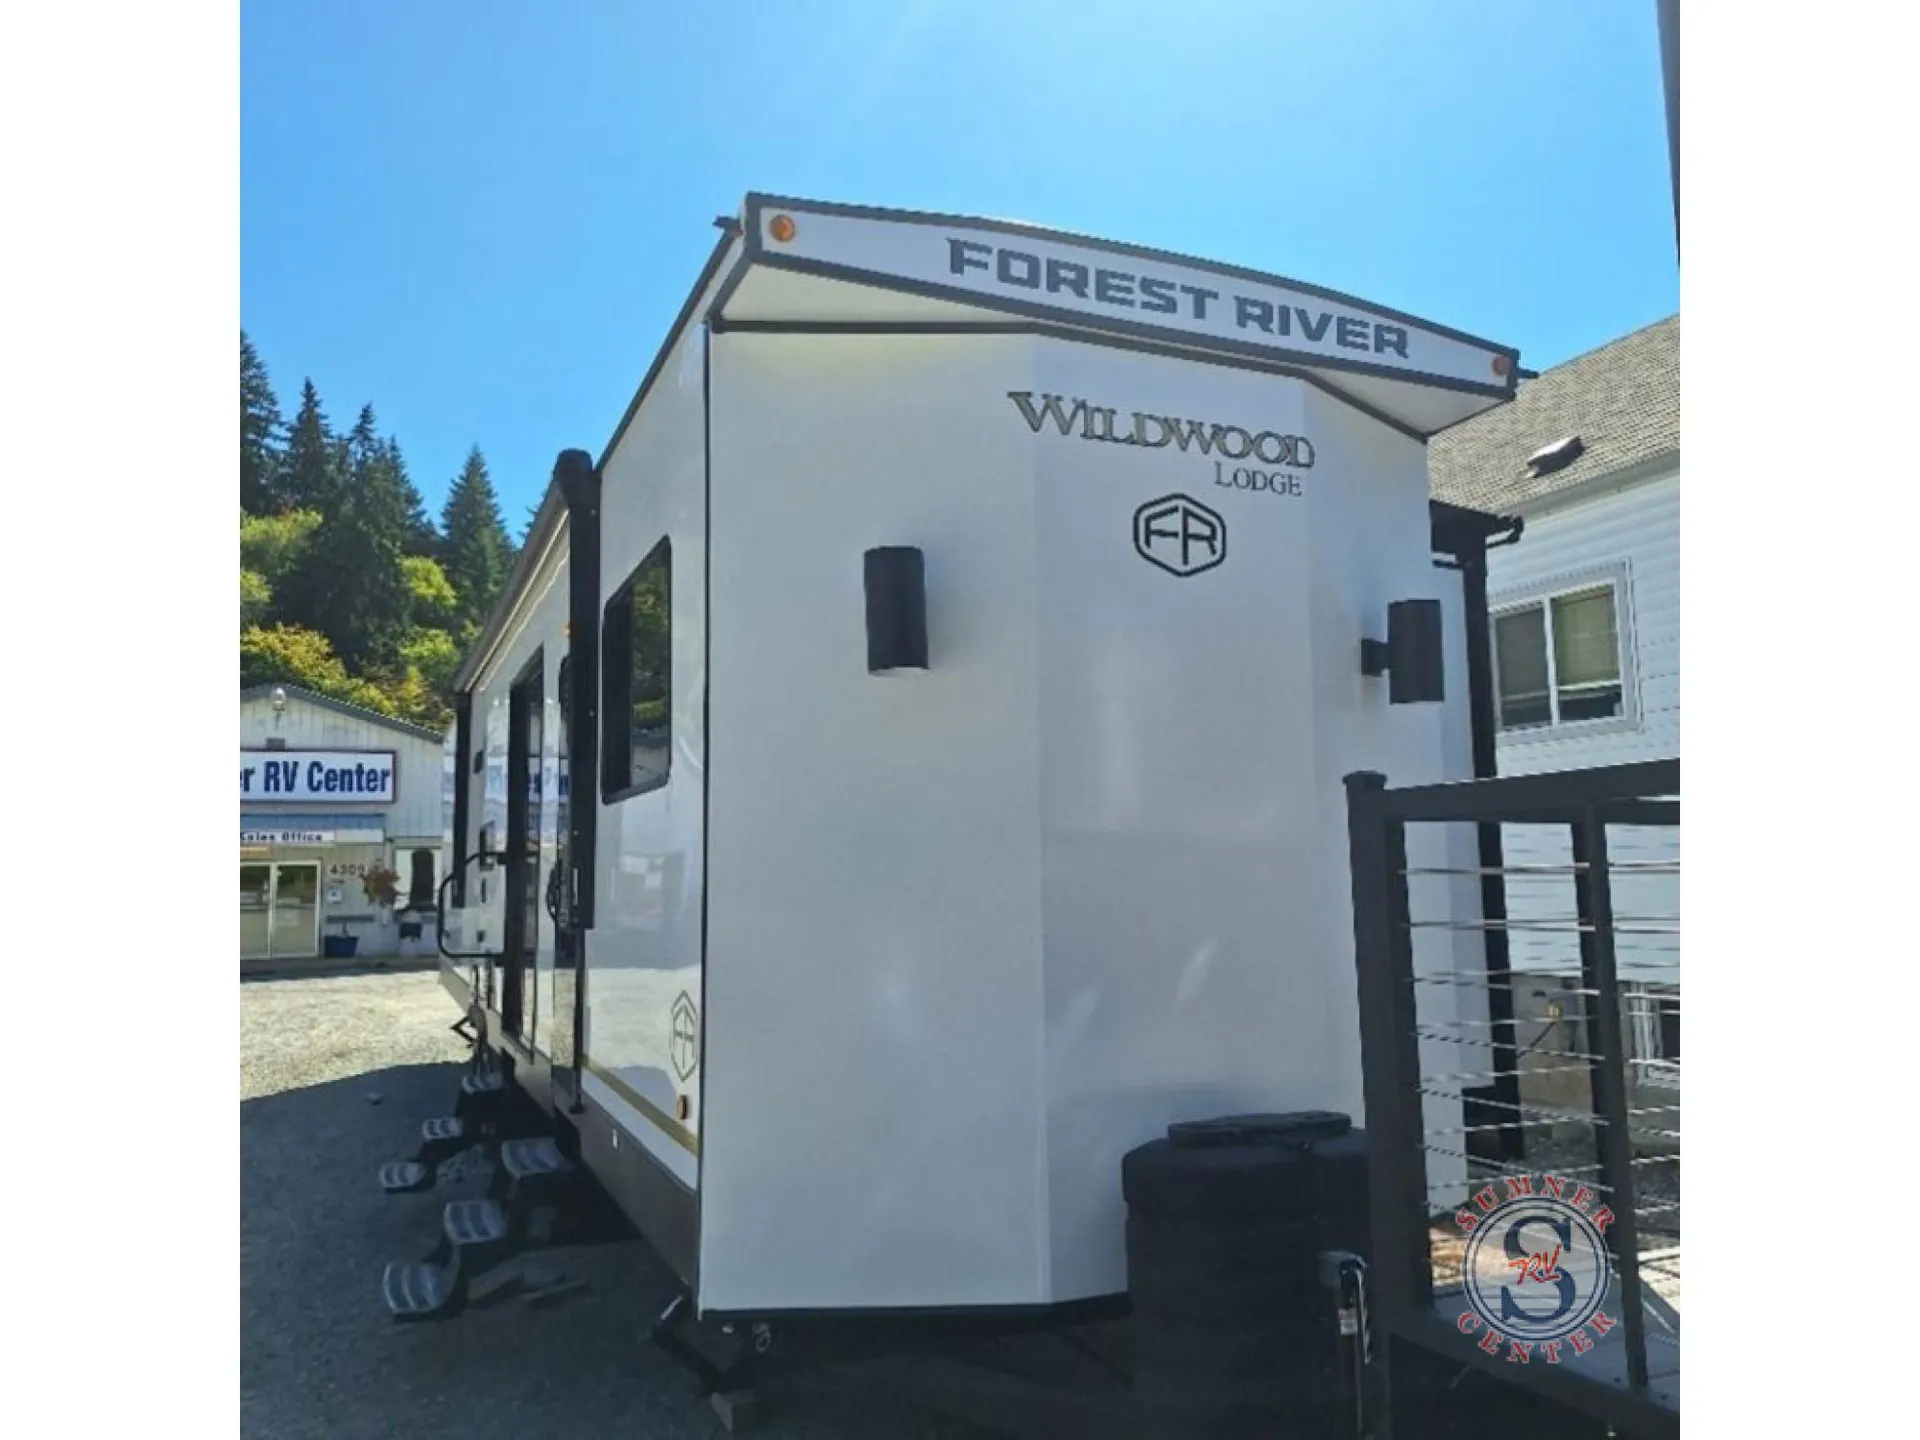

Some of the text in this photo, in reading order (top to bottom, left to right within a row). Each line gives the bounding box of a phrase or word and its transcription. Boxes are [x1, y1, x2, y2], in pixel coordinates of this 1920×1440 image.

[946, 238, 1409, 359] FOREST RIVER
[1006, 391, 1316, 469] WILDWOOD
[1213, 460, 1303, 497] LODGE
[1144, 505, 1218, 566] FR
[240, 760, 391, 793] r RV Center
